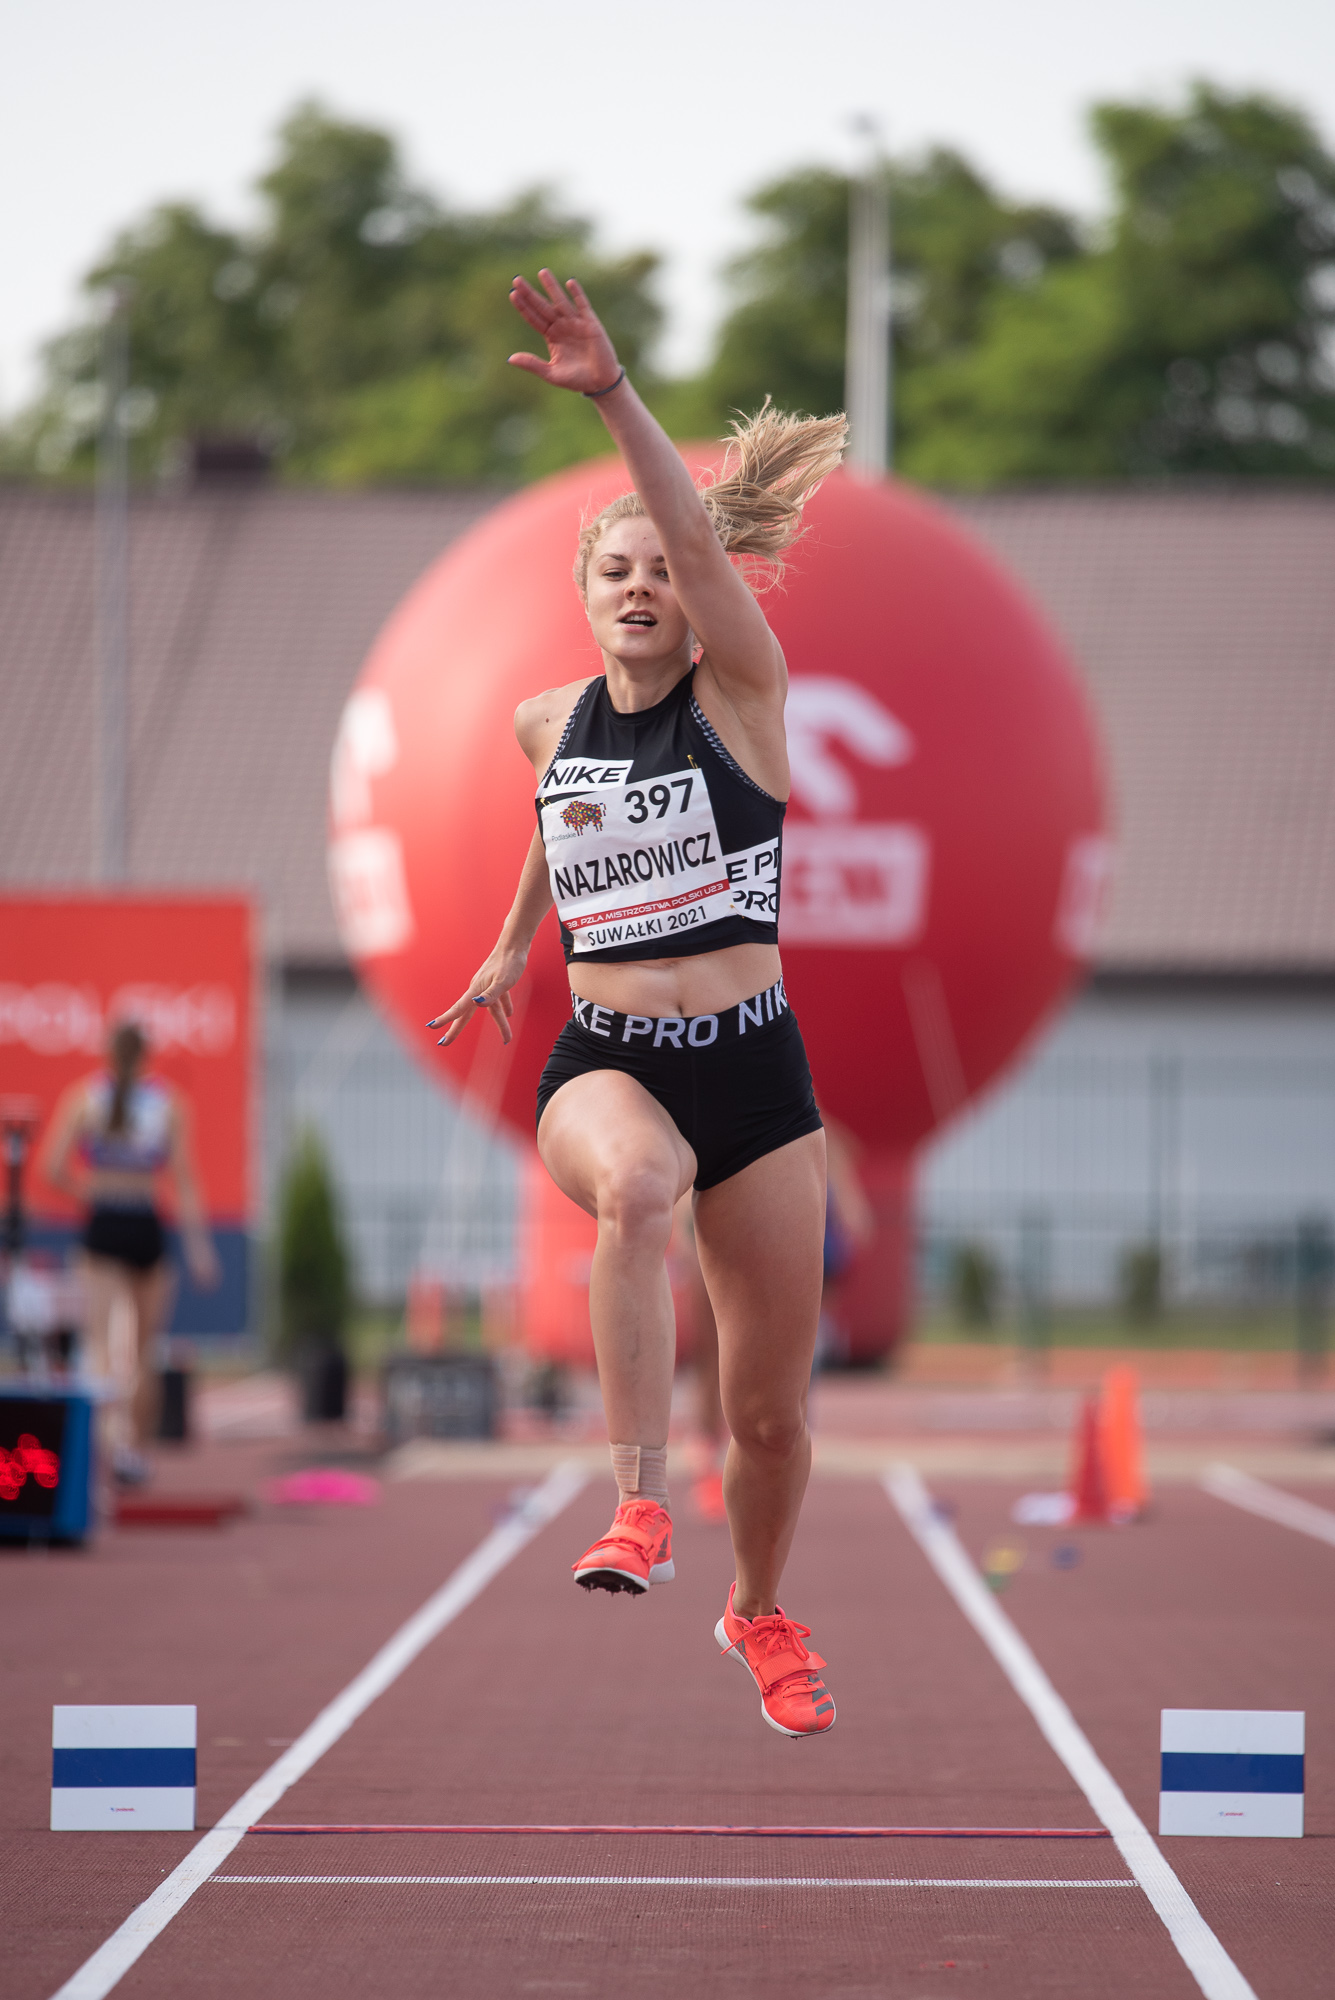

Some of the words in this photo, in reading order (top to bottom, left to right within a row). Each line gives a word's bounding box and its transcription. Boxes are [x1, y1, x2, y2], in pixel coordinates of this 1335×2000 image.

[543, 766, 628, 788] NIKE
[624, 777, 693, 824] 397
[551, 832, 577, 842] Podlaskie
[554, 832, 716, 900] NAZAROWICZ
[581, 915, 604, 926] PZLA
[605, 902, 670, 920] MISTRZOSTWA
[672, 891, 703, 907] POLSKI
[704, 883, 724, 894] U23
[587, 918, 662, 946] SUWAŁKI
[667, 905, 707, 930] 2021
[621, 1014, 719, 1048] PRO
[738, 975, 787, 1035] NIK
